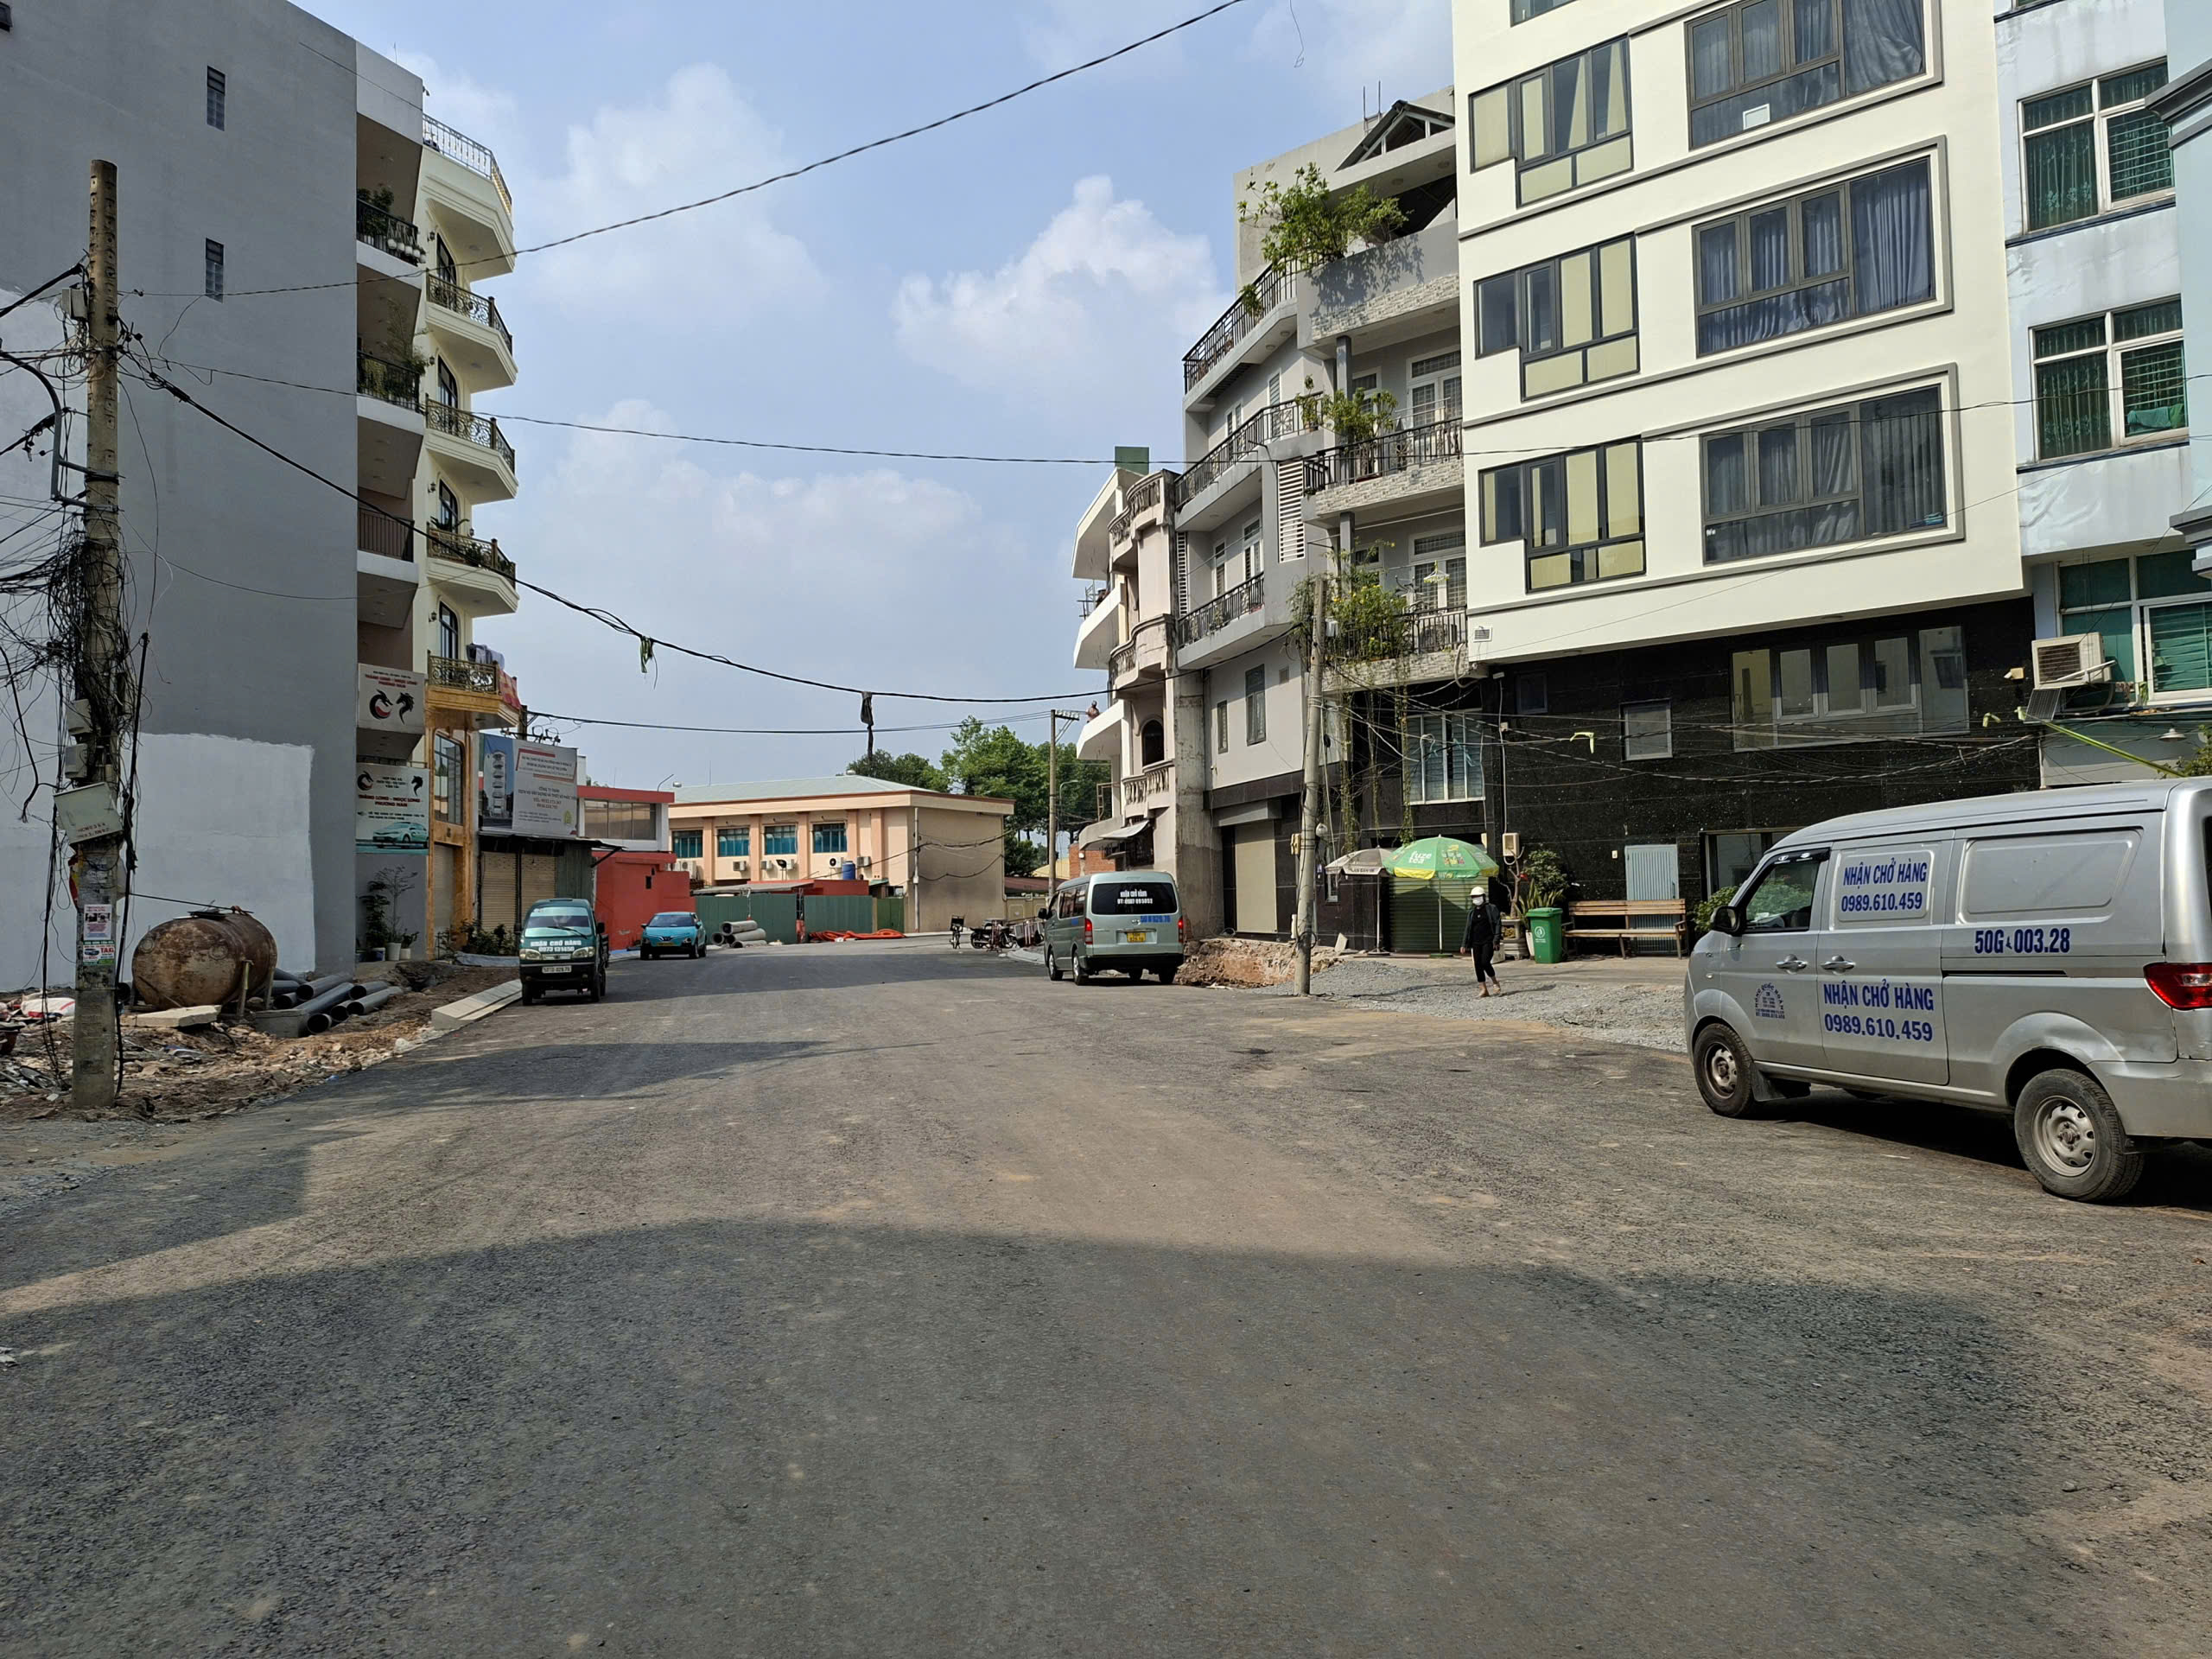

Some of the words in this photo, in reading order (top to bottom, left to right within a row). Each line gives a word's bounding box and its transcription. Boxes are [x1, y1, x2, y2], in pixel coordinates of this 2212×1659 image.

[1411, 850, 1432, 859] fuze
[1843, 861, 1871, 889] NHẬN
[1872, 857, 1897, 884] CHỞ
[1897, 858, 1927, 883] HÀNG
[1841, 892, 1923, 912] 0989.610.459
[1824, 980, 1859, 1009] NHẬN
[1862, 978, 1890, 1007] CHỞ
[1894, 982, 1934, 1011] HÀNG
[1824, 1014, 1933, 1042] 0989.610.459
